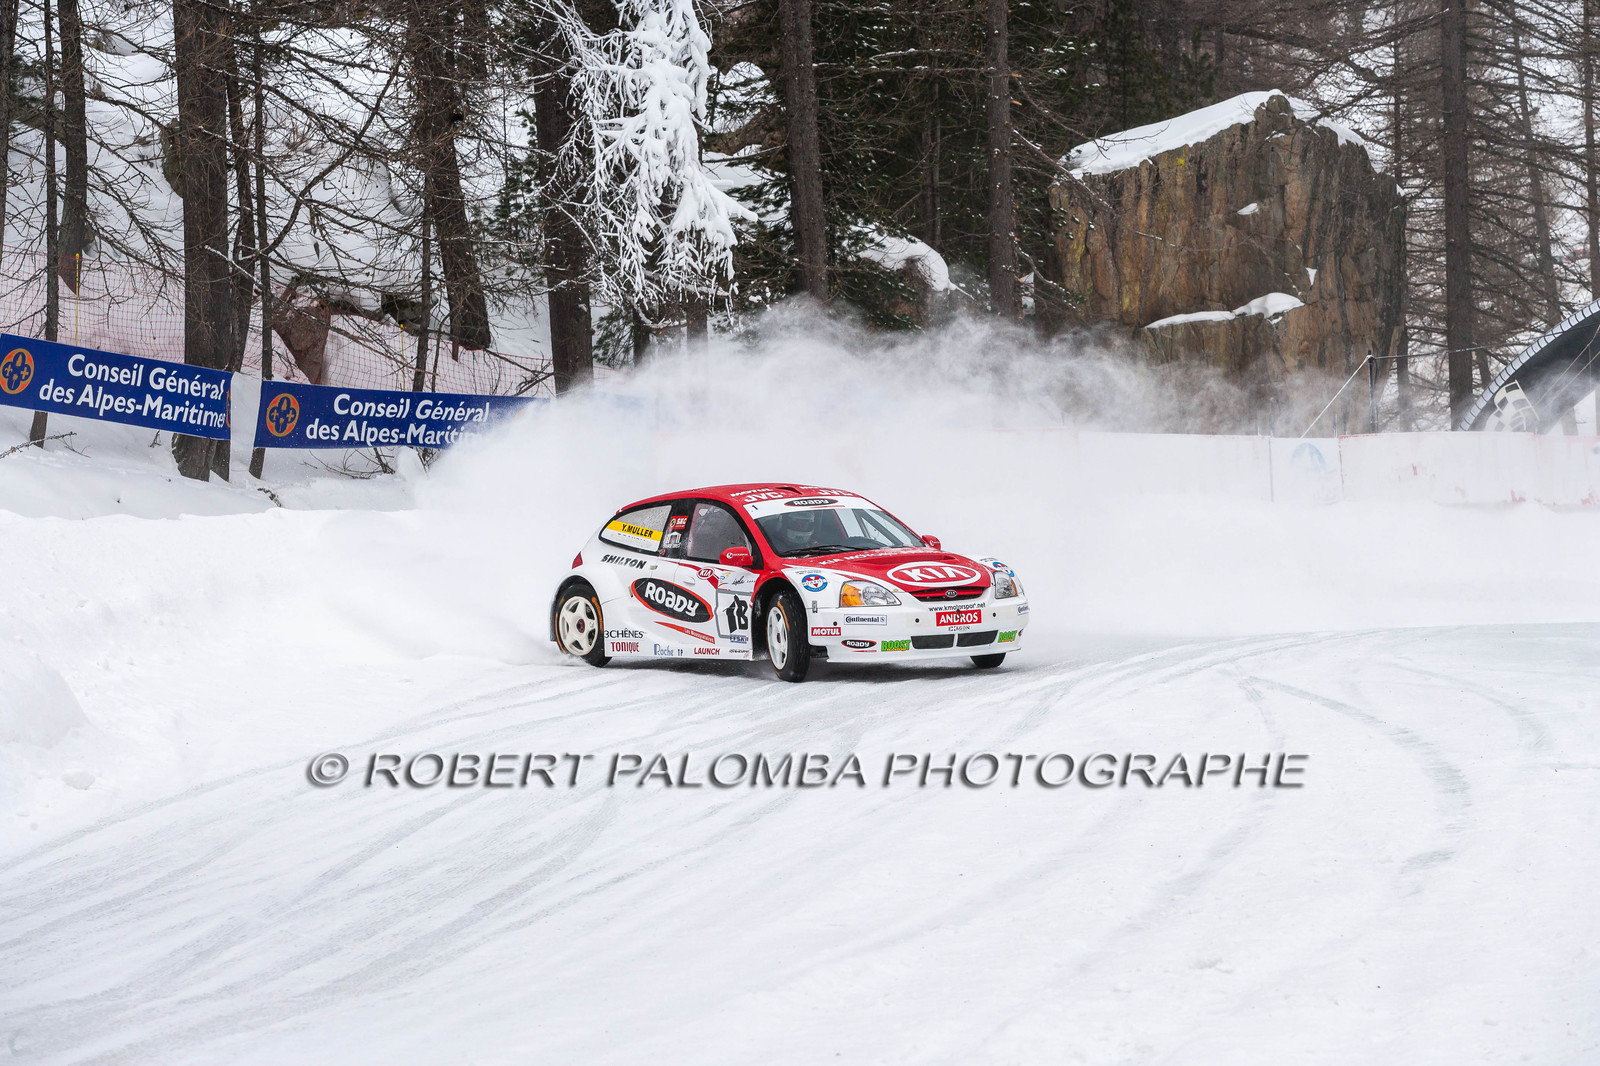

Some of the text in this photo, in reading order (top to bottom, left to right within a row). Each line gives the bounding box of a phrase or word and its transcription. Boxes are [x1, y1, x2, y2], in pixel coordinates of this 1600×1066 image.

[68, 353, 226, 400] Conseil Général
[39, 378, 226, 429] des Alpes-Maritimes
[333, 393, 490, 422] Conseil Général
[306, 418, 339, 441] des
[730, 488, 774, 498] MOTUL
[743, 491, 784, 503] JVC
[621, 523, 654, 539] Y.MULLER
[600, 554, 647, 569] SHILTON
[900, 566, 971, 582] KIA
[845, 615, 880, 623] Continental
[939, 611, 979, 624] ANDROS
[812, 628, 840, 636] MOTUL
[610, 641, 640, 653] TONIQUE
[694, 647, 720, 655] LAUNCH
[881, 640, 912, 651] BOOST
